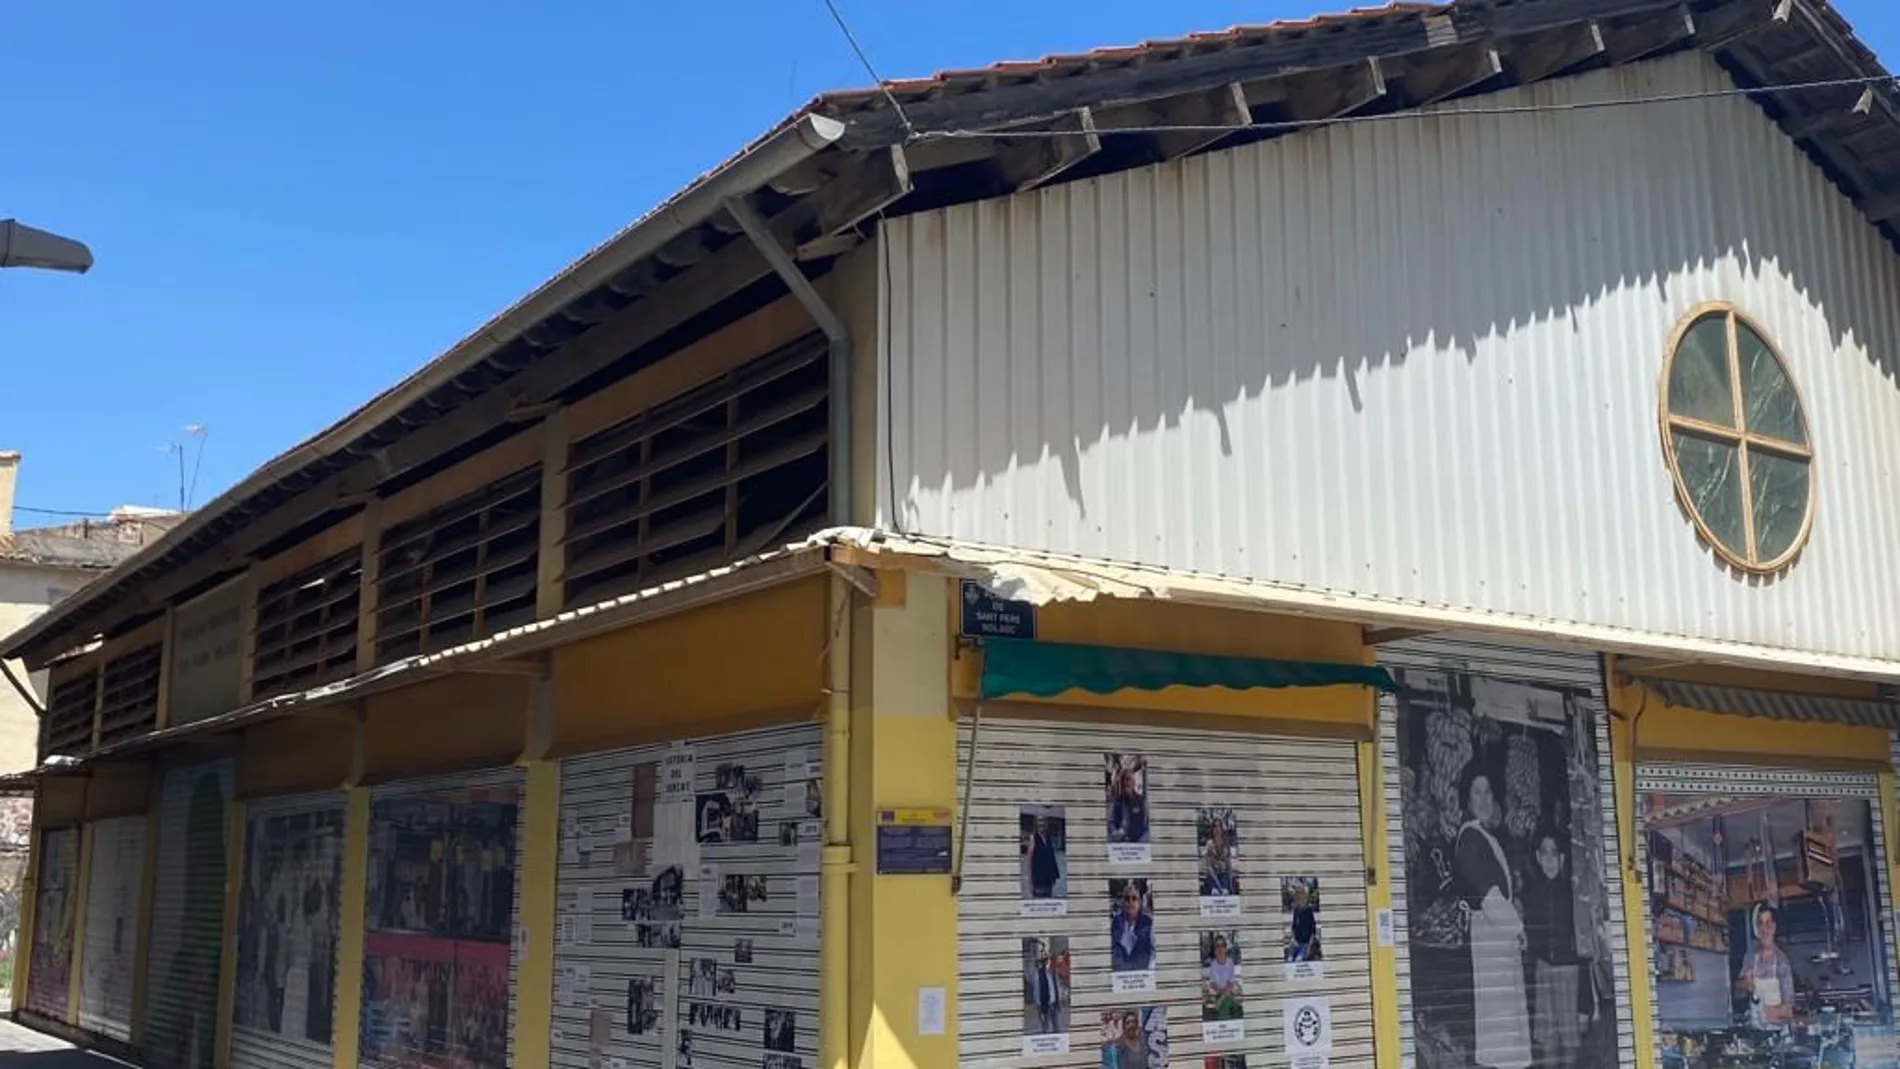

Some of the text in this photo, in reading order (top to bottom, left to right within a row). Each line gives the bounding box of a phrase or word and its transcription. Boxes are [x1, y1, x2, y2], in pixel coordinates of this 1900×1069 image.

[992, 602, 1004, 611] DE
[976, 611, 1020, 624] SANT PERE
